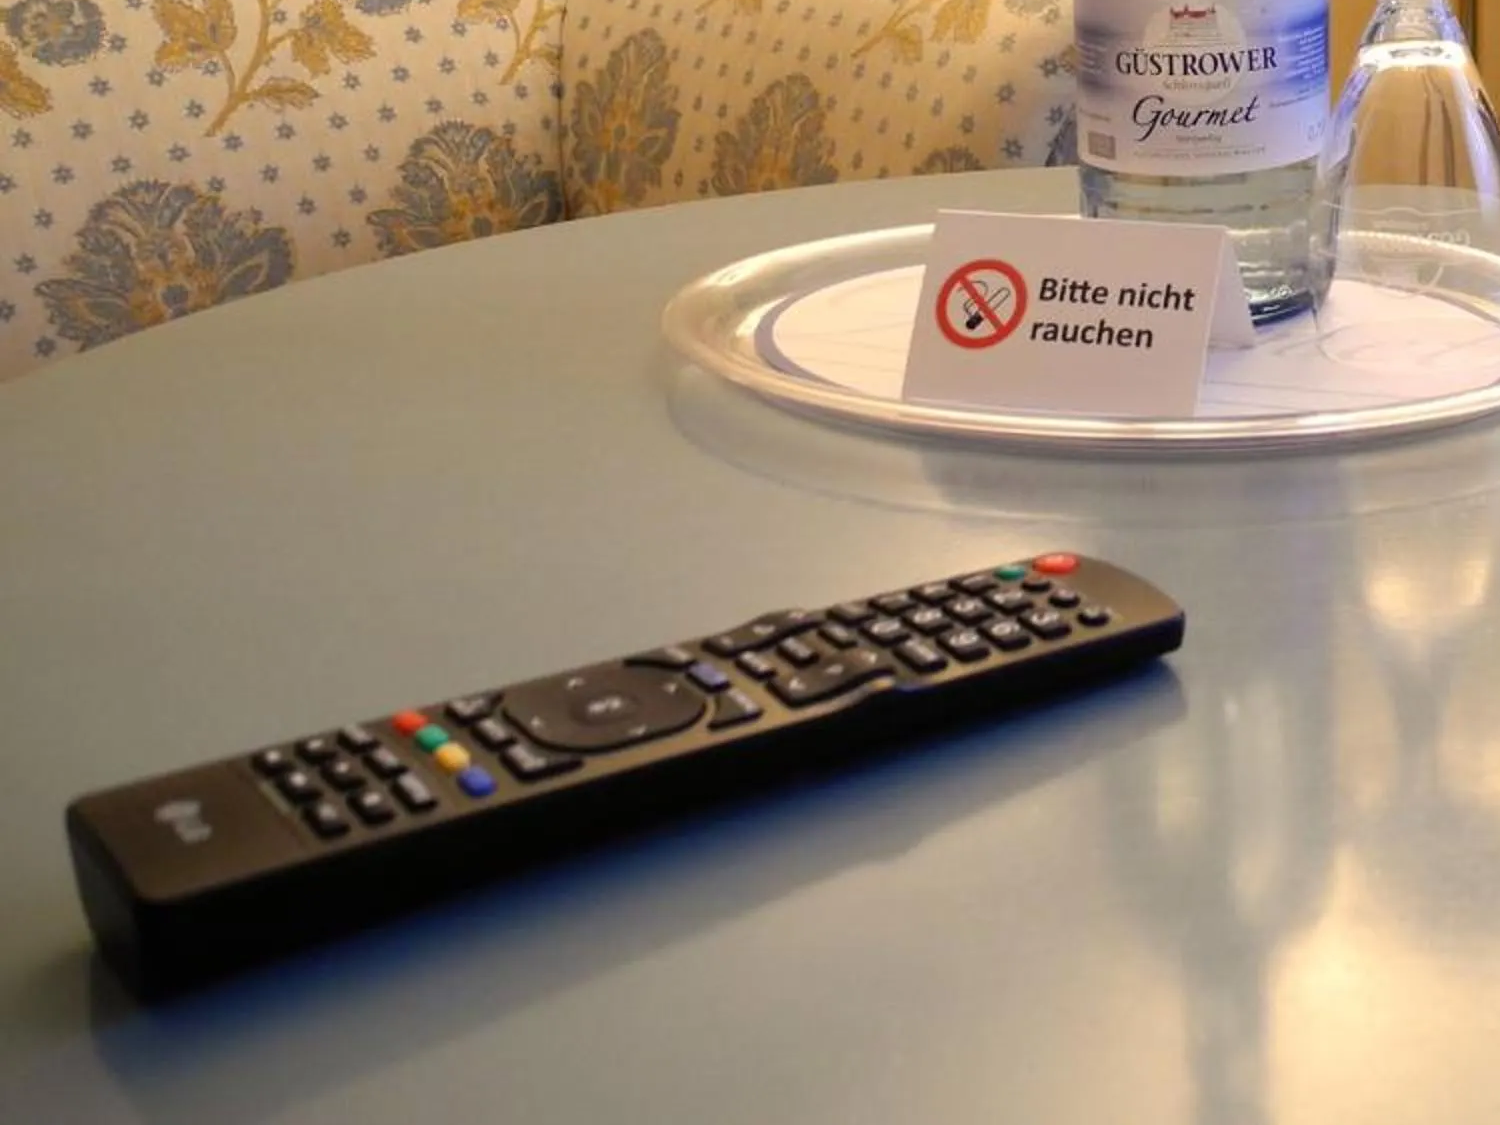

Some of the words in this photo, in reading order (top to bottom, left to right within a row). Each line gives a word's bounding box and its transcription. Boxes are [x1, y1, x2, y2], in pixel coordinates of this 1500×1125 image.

[1115, 46, 1278, 76] GÜSTROWER
[1132, 94, 1260, 142] Gourmet
[1039, 277, 1109, 305] Bitte
[1118, 283, 1195, 312] nicht
[1030, 319, 1154, 349] rauchen
